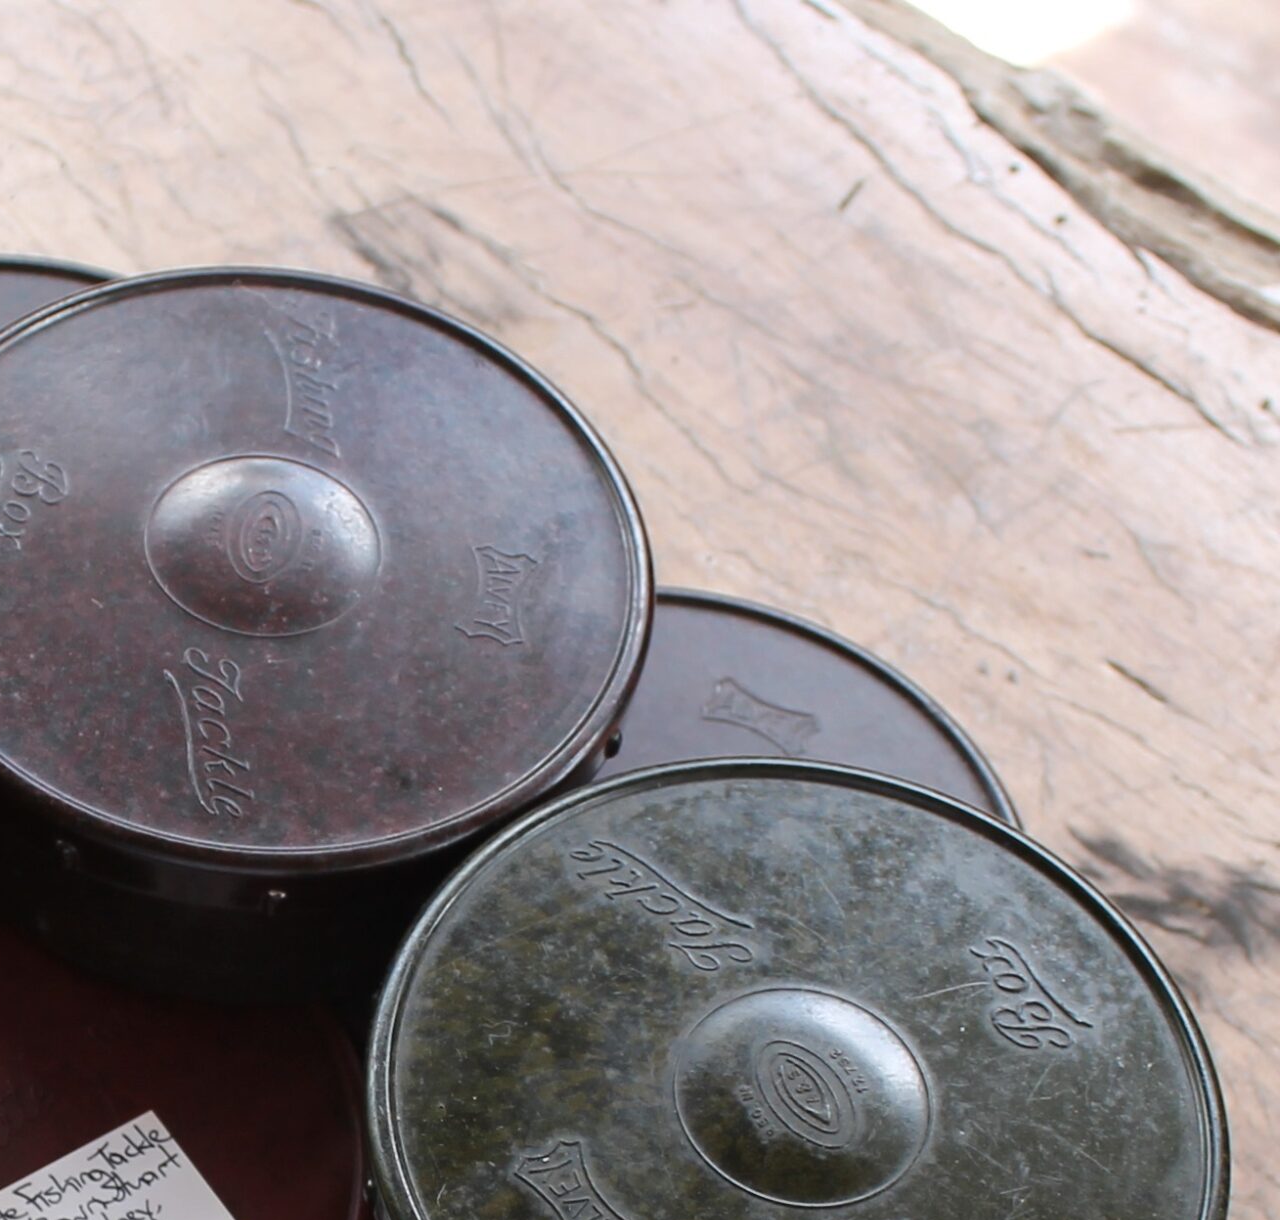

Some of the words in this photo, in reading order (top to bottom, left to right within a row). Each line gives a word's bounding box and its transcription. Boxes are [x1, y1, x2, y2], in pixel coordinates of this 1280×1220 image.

[180, 646, 256, 818] Tackle
[570, 845, 754, 972] Tackle
[970, 937, 1074, 1051] Box
[12, 1168, 116, 1220] Fishing
[87, 1124, 169, 1170] Tackle
[95, 1149, 181, 1205] Stuart
